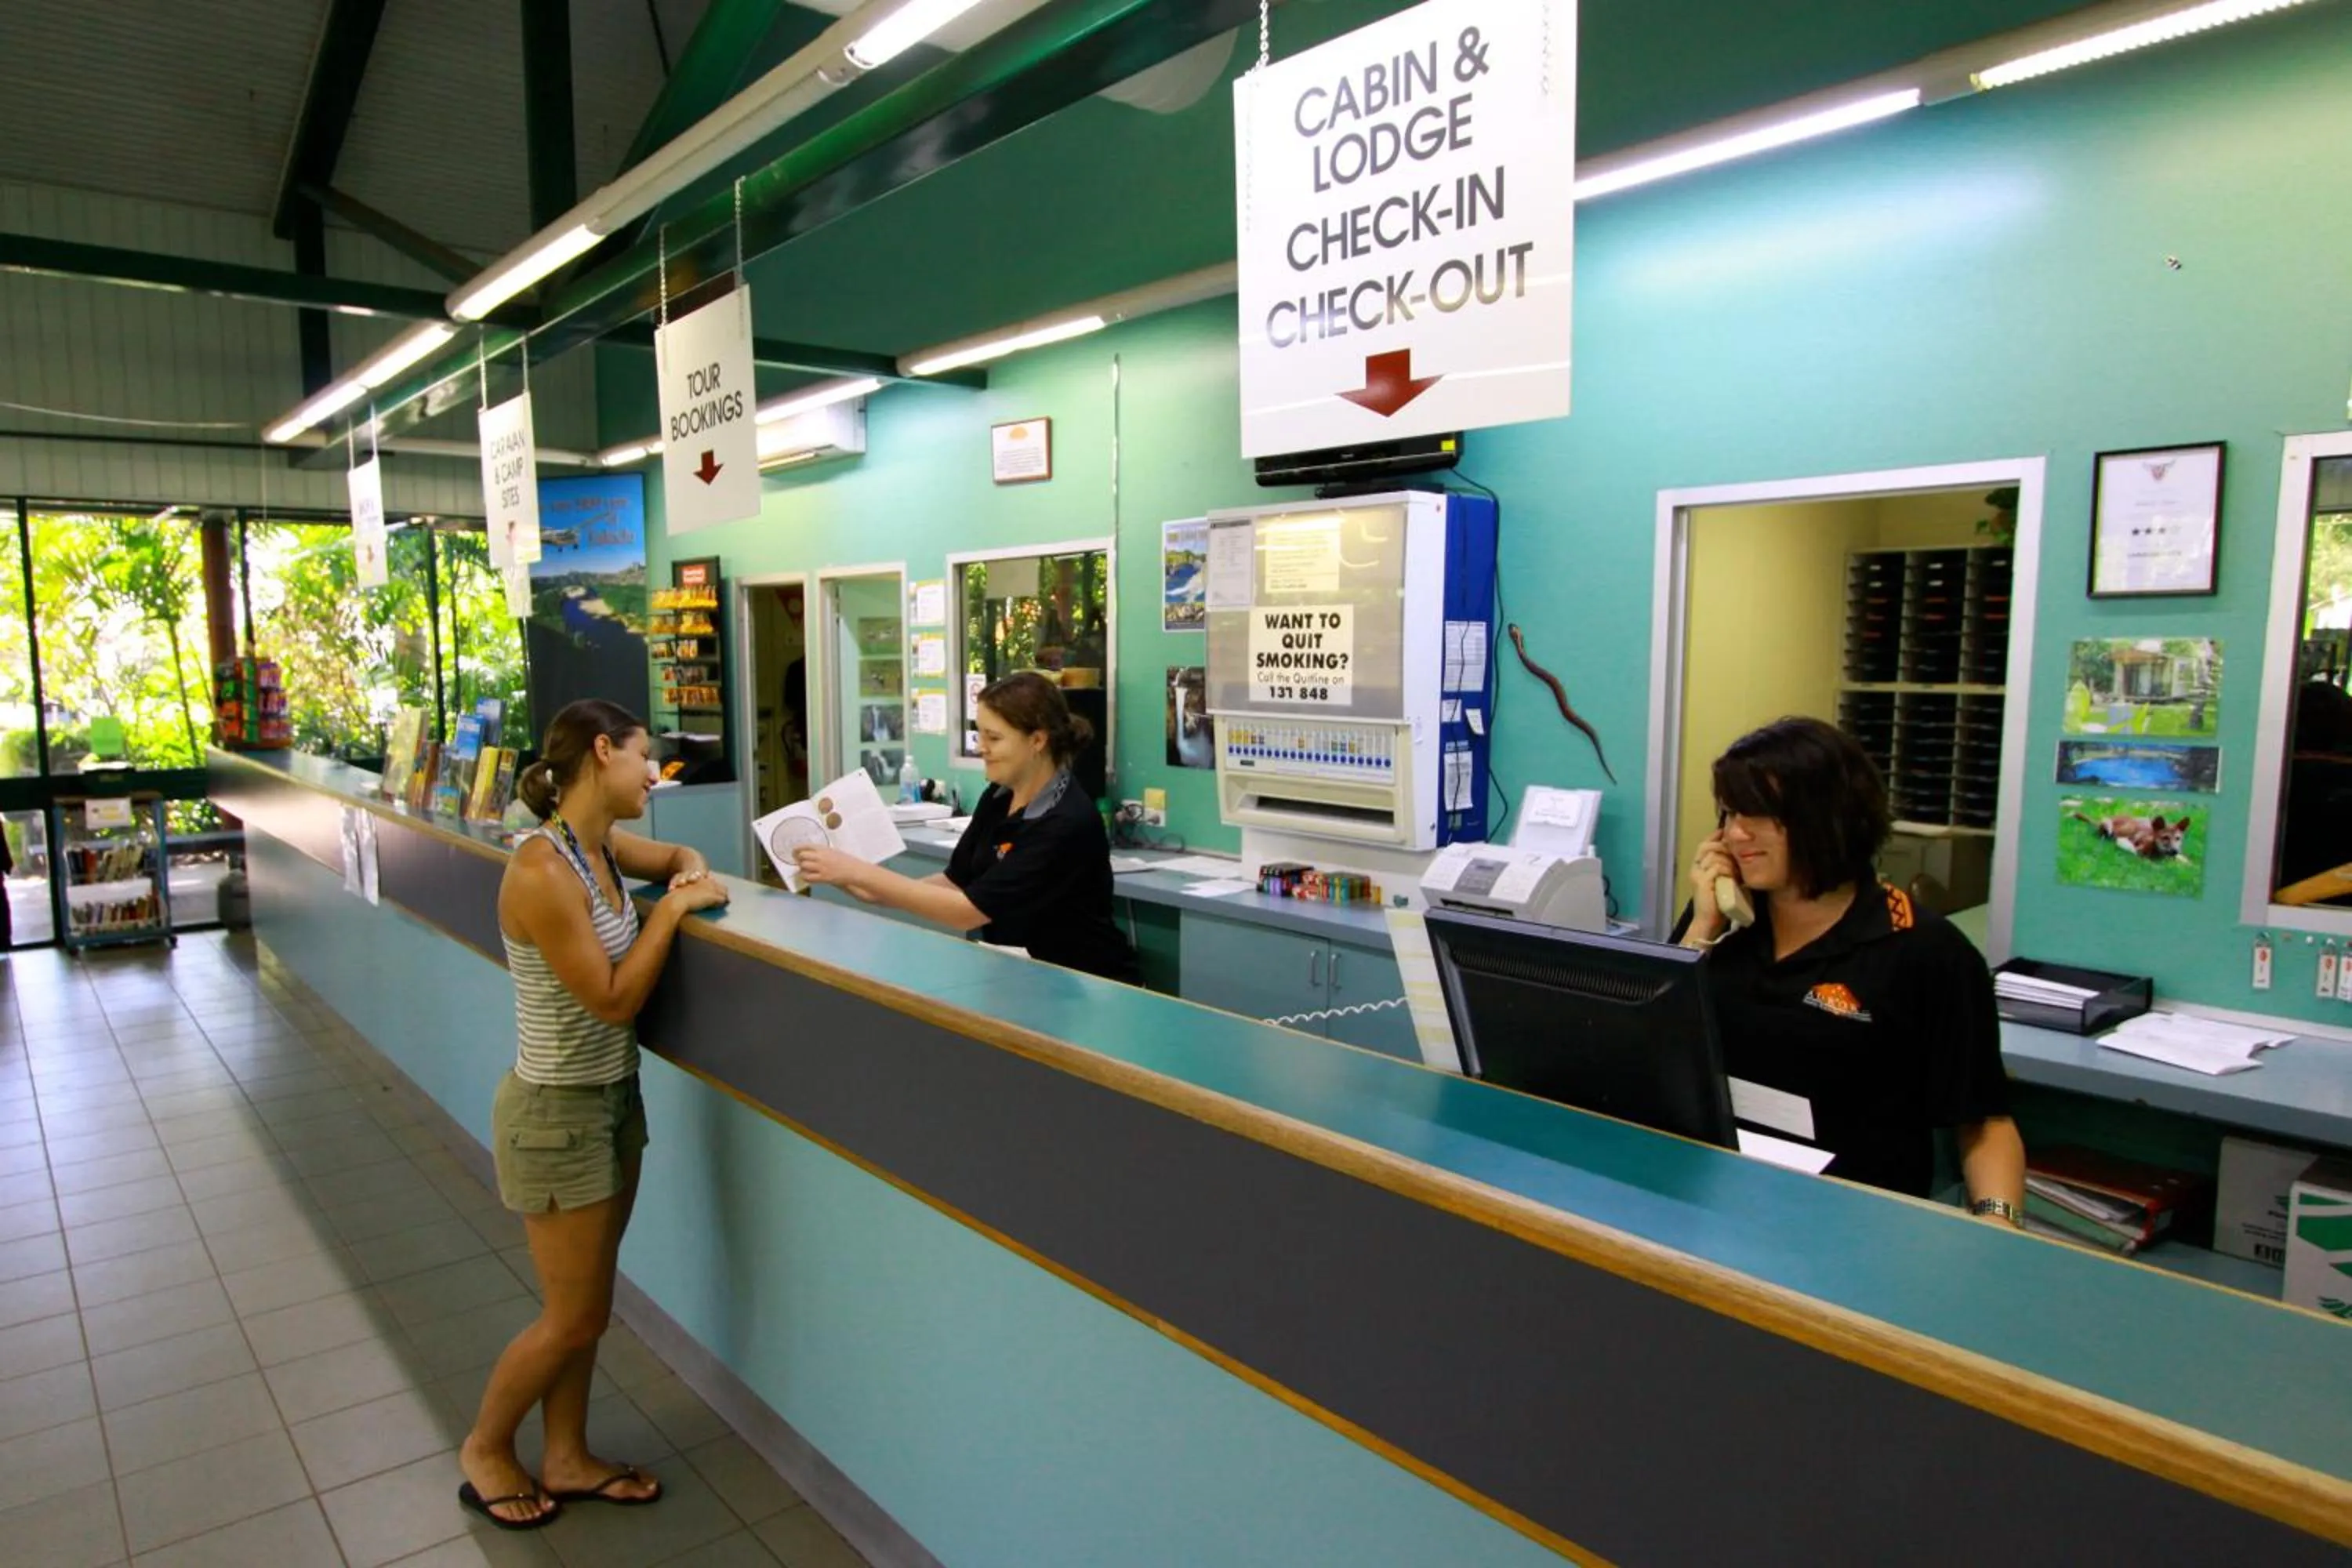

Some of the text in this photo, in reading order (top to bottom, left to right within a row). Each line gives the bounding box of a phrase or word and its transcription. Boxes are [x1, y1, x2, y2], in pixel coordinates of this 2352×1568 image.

[1294, 26, 1490, 137] CABIN &
[1313, 93, 1472, 193] LODGE
[1287, 165, 1504, 271] CHECK-IN
[1267, 241, 1534, 348] CHECK-OUT
[687, 362, 720, 400] TOUR
[671, 390, 742, 441] BOOKINGS
[502, 456, 524, 482] CAMP
[502, 485, 519, 510] SITES
[1265, 612, 1341, 629] WANT TO
[1282, 633, 1323, 649] QUIT
[1256, 652, 1348, 670] SMOKING?
[1276, 672, 1290, 683] the
[1299, 687, 1328, 700] 848
